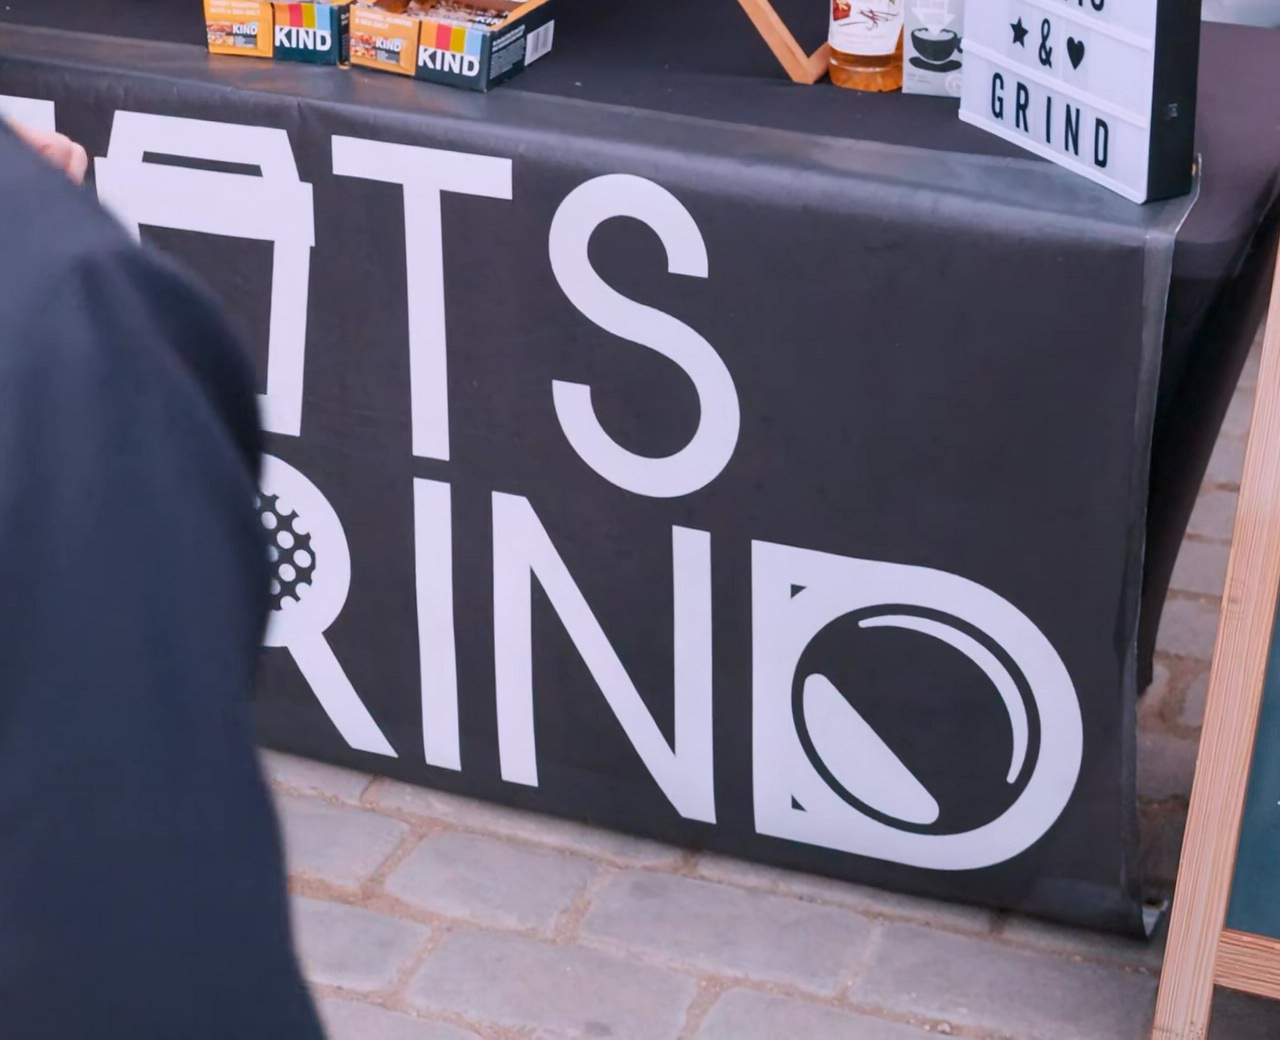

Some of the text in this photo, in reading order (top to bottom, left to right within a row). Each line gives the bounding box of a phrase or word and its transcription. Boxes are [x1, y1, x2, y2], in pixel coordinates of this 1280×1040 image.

[274, 25, 332, 52] KIND
[1038, 17, 1054, 69] &
[418, 46, 481, 78] KIND
[991, 71, 1110, 170] GRIND
